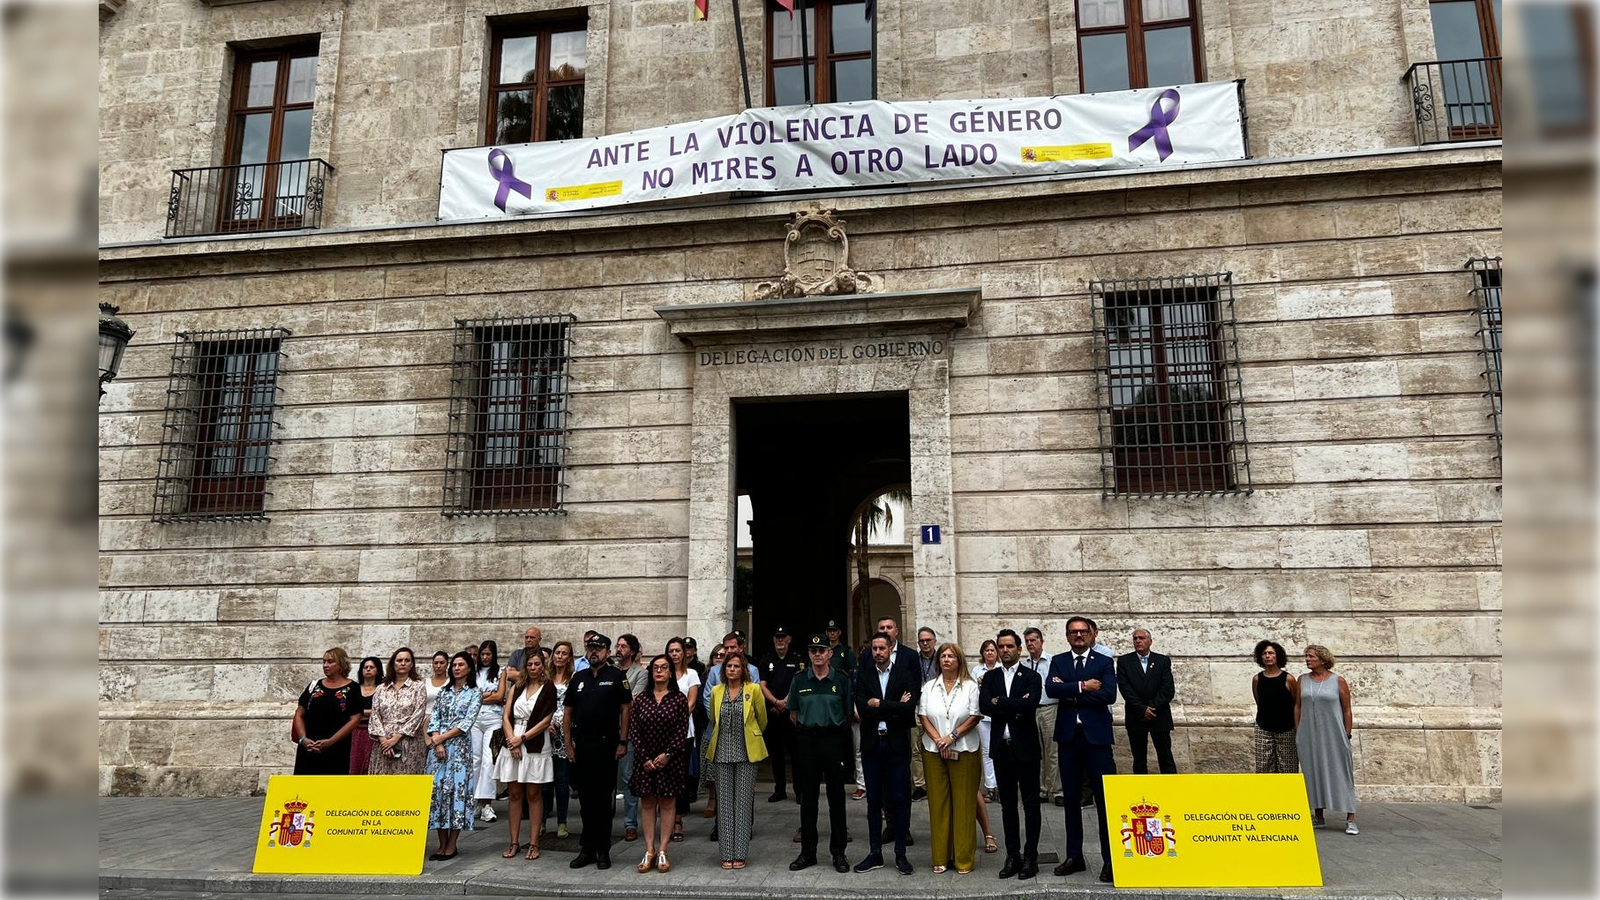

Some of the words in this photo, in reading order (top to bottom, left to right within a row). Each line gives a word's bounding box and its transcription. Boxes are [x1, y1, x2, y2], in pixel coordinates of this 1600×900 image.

[586, 140, 650, 169] ANTE
[669, 132, 700, 156] LA
[717, 114, 875, 148] VIOLENCIA
[894, 111, 929, 135] DE
[949, 106, 1063, 134] GÉNERO
[642, 166, 674, 191] NO
[692, 155, 777, 184] MIRES
[795, 153, 814, 178] A
[831, 147, 904, 176] OTRO
[925, 142, 998, 169] LADO
[700, 347, 815, 366] DELEGACION
[819, 347, 848, 360] DEL
[852, 340, 943, 359] GOBIERNO
[926, 527, 933, 542] 1
[325, 809, 369, 817] DELEGACIÓN
[1184, 812, 1238, 821] DELEGACIÓN
[1239, 813, 1255, 821] DEL
[1257, 813, 1301, 821] GOBIERNO
[326, 828, 368, 836] COMUNITAT
[370, 828, 414, 836] VALENCIANA
[1192, 834, 1242, 842] COMUNITAT
[1246, 834, 1300, 842] VALENCIANA
